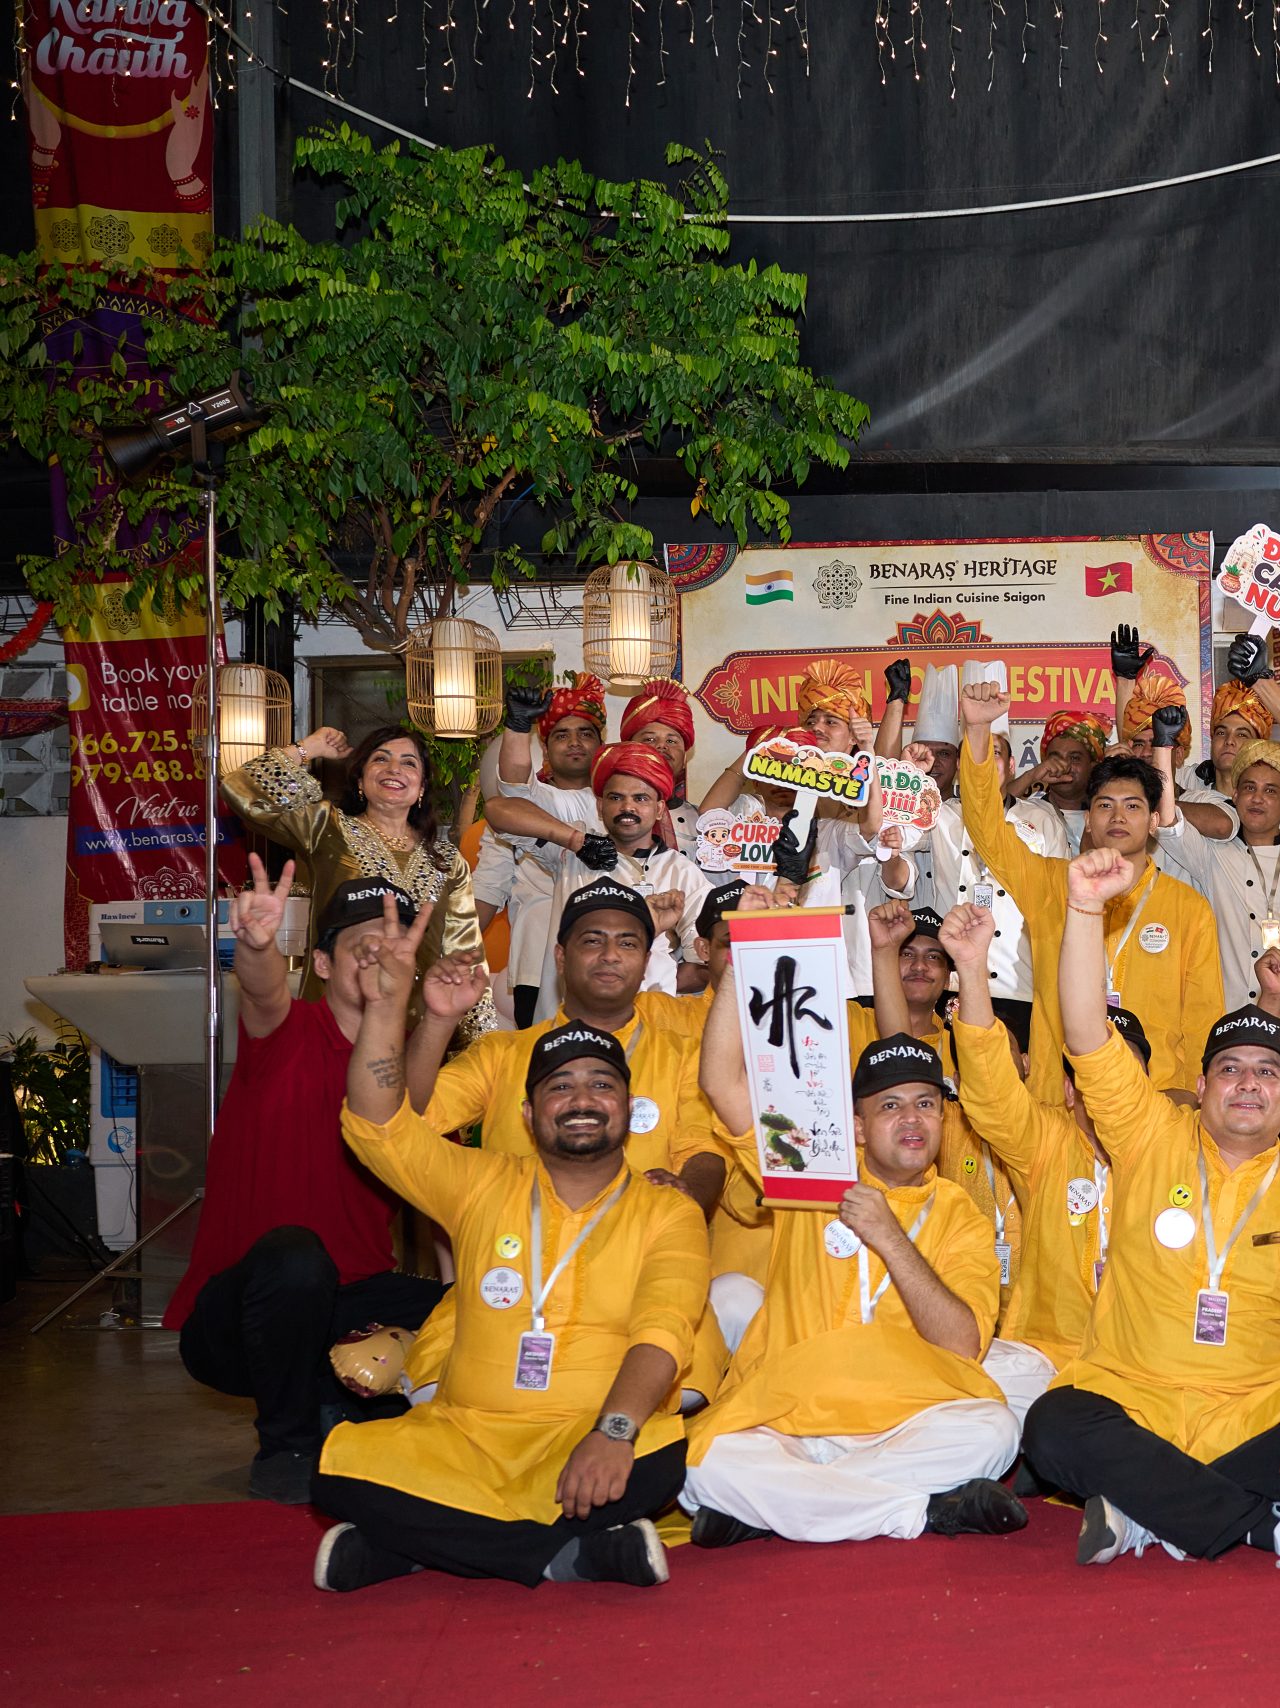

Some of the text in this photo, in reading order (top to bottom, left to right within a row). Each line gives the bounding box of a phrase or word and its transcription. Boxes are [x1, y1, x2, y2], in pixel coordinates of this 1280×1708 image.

[36, 28, 192, 79] Chauth
[884, 591, 1046, 605] Fine Indian Cuisine Saigon
[101, 658, 208, 688] Book you
[1014, 665, 1117, 704] ESTIVA
[101, 687, 193, 713] table no
[749, 754, 862, 799] NAMASTE
[115, 793, 200, 825] Visit us
[731, 822, 783, 844] CURR
[740, 843, 774, 862] LOV
